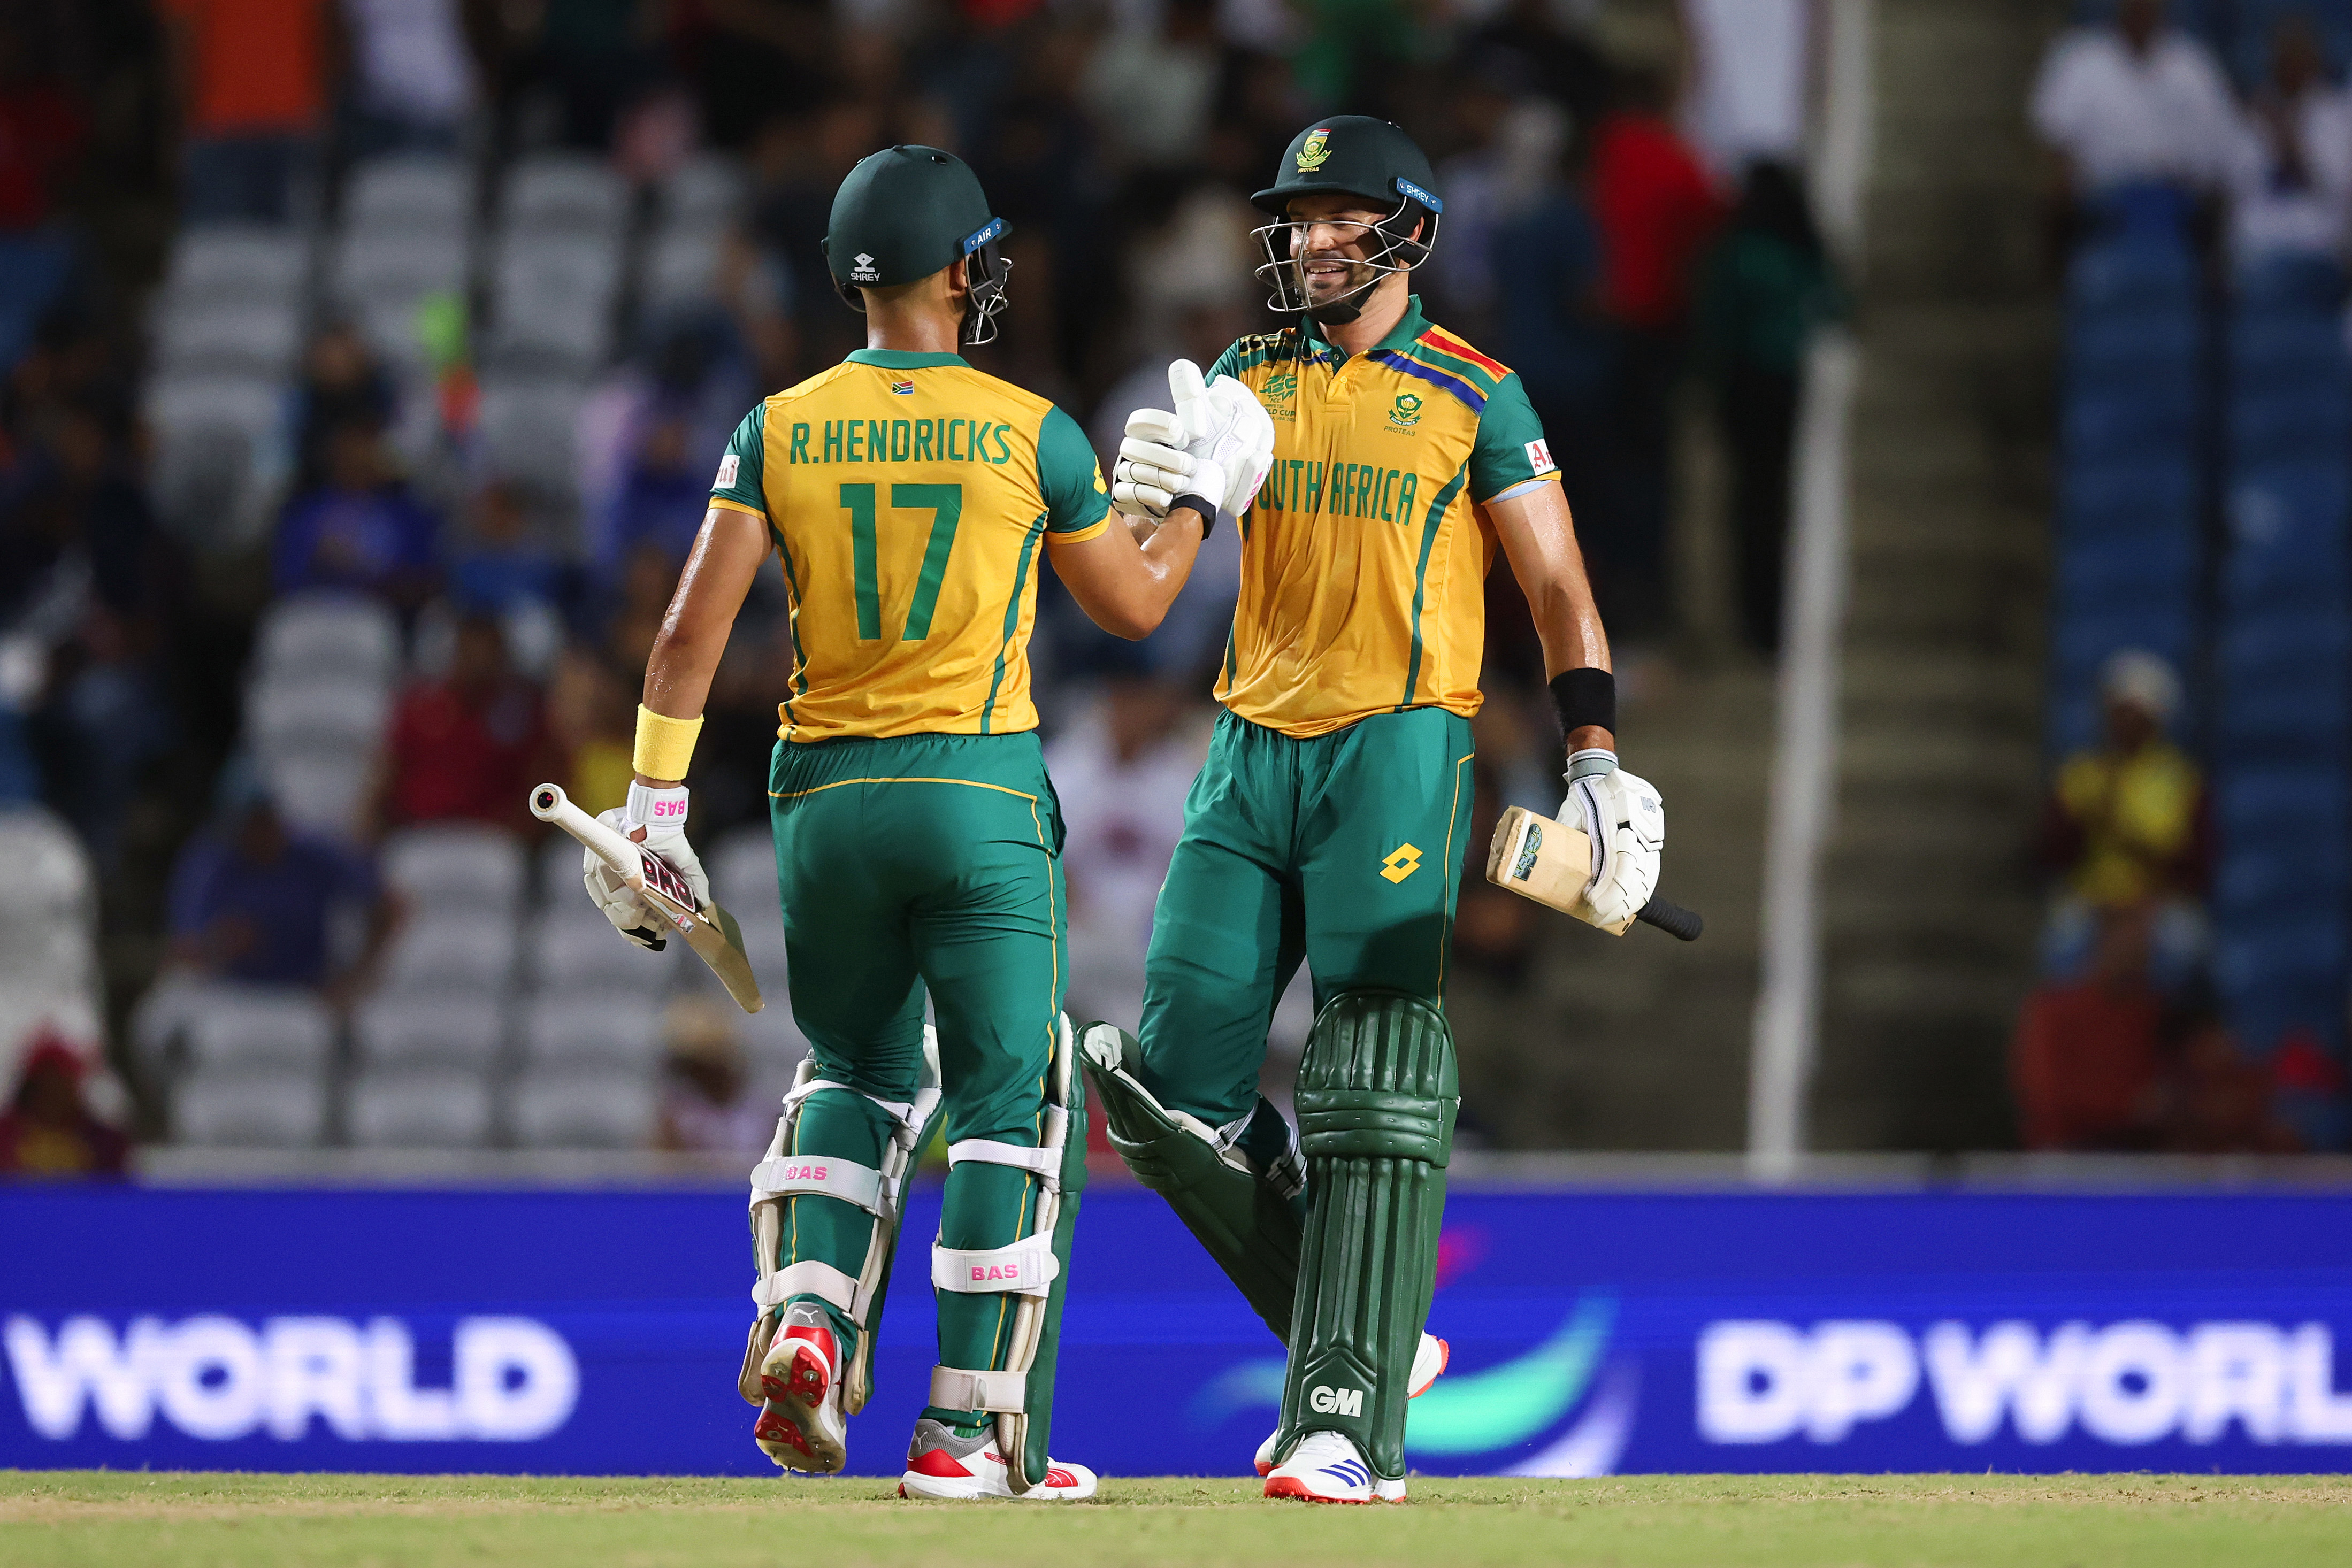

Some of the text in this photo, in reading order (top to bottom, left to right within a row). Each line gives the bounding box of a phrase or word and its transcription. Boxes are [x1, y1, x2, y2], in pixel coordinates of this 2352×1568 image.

[1406, 185, 1429, 203] SHREY
[977, 228, 991, 245] AIR
[850, 272, 880, 282] SHREY
[1384, 426, 1415, 437] PROTEAS
[790, 418, 1012, 464] R.HENDRICKS
[1257, 459, 1418, 526] OUTH AFRICA
[839, 483, 962, 641] 17
[654, 800, 685, 816] BAS
[785, 1166, 828, 1180] BAS
[971, 1264, 1018, 1280] BAS
[3, 1316, 580, 1441] WORLD
[1696, 1319, 2352, 1443] DP WORL
[1310, 1386, 1363, 1417] GM
